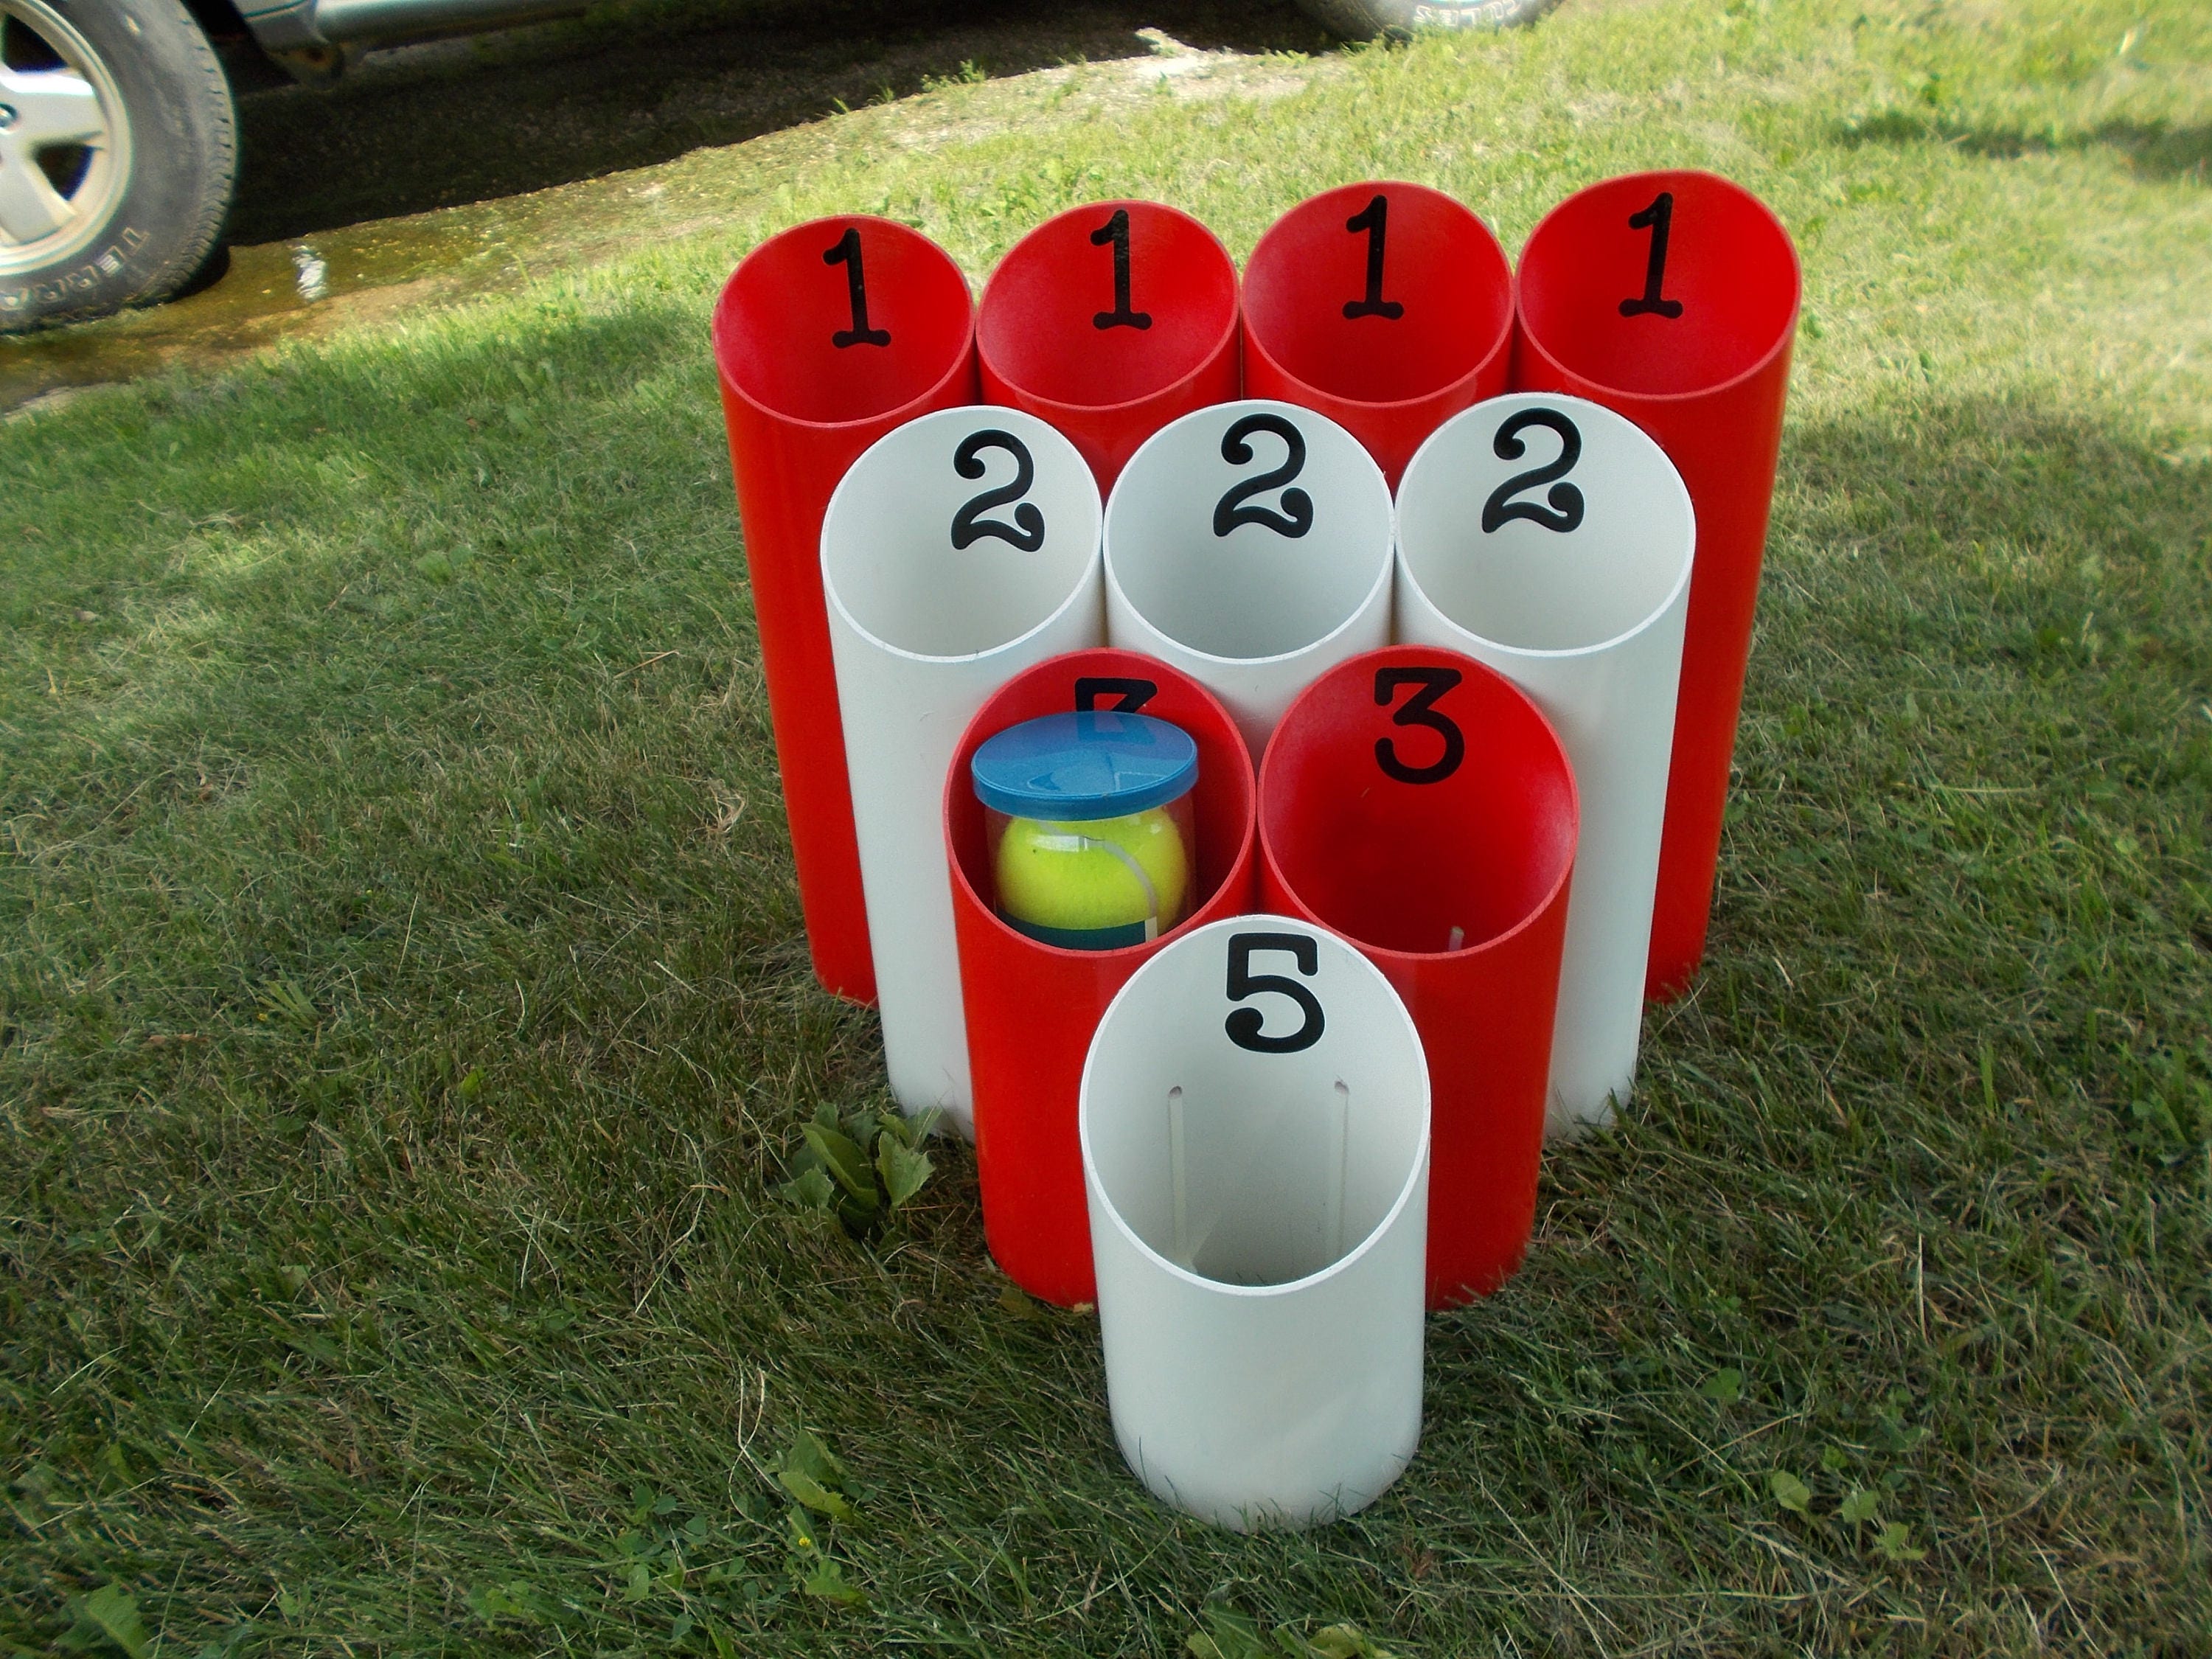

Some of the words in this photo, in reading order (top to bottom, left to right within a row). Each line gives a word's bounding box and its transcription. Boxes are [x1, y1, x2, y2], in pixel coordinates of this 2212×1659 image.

[823, 229, 891, 348] 1
[1091, 210, 1152, 330] 1
[1343, 195, 1404, 319] 1
[1619, 192, 1683, 319] 1
[951, 430, 1044, 552] 2
[1214, 414, 1313, 538] 2
[1482, 408, 1584, 533] 2
[1374, 667, 1464, 785] 3
[1225, 933, 1324, 1053] 5
